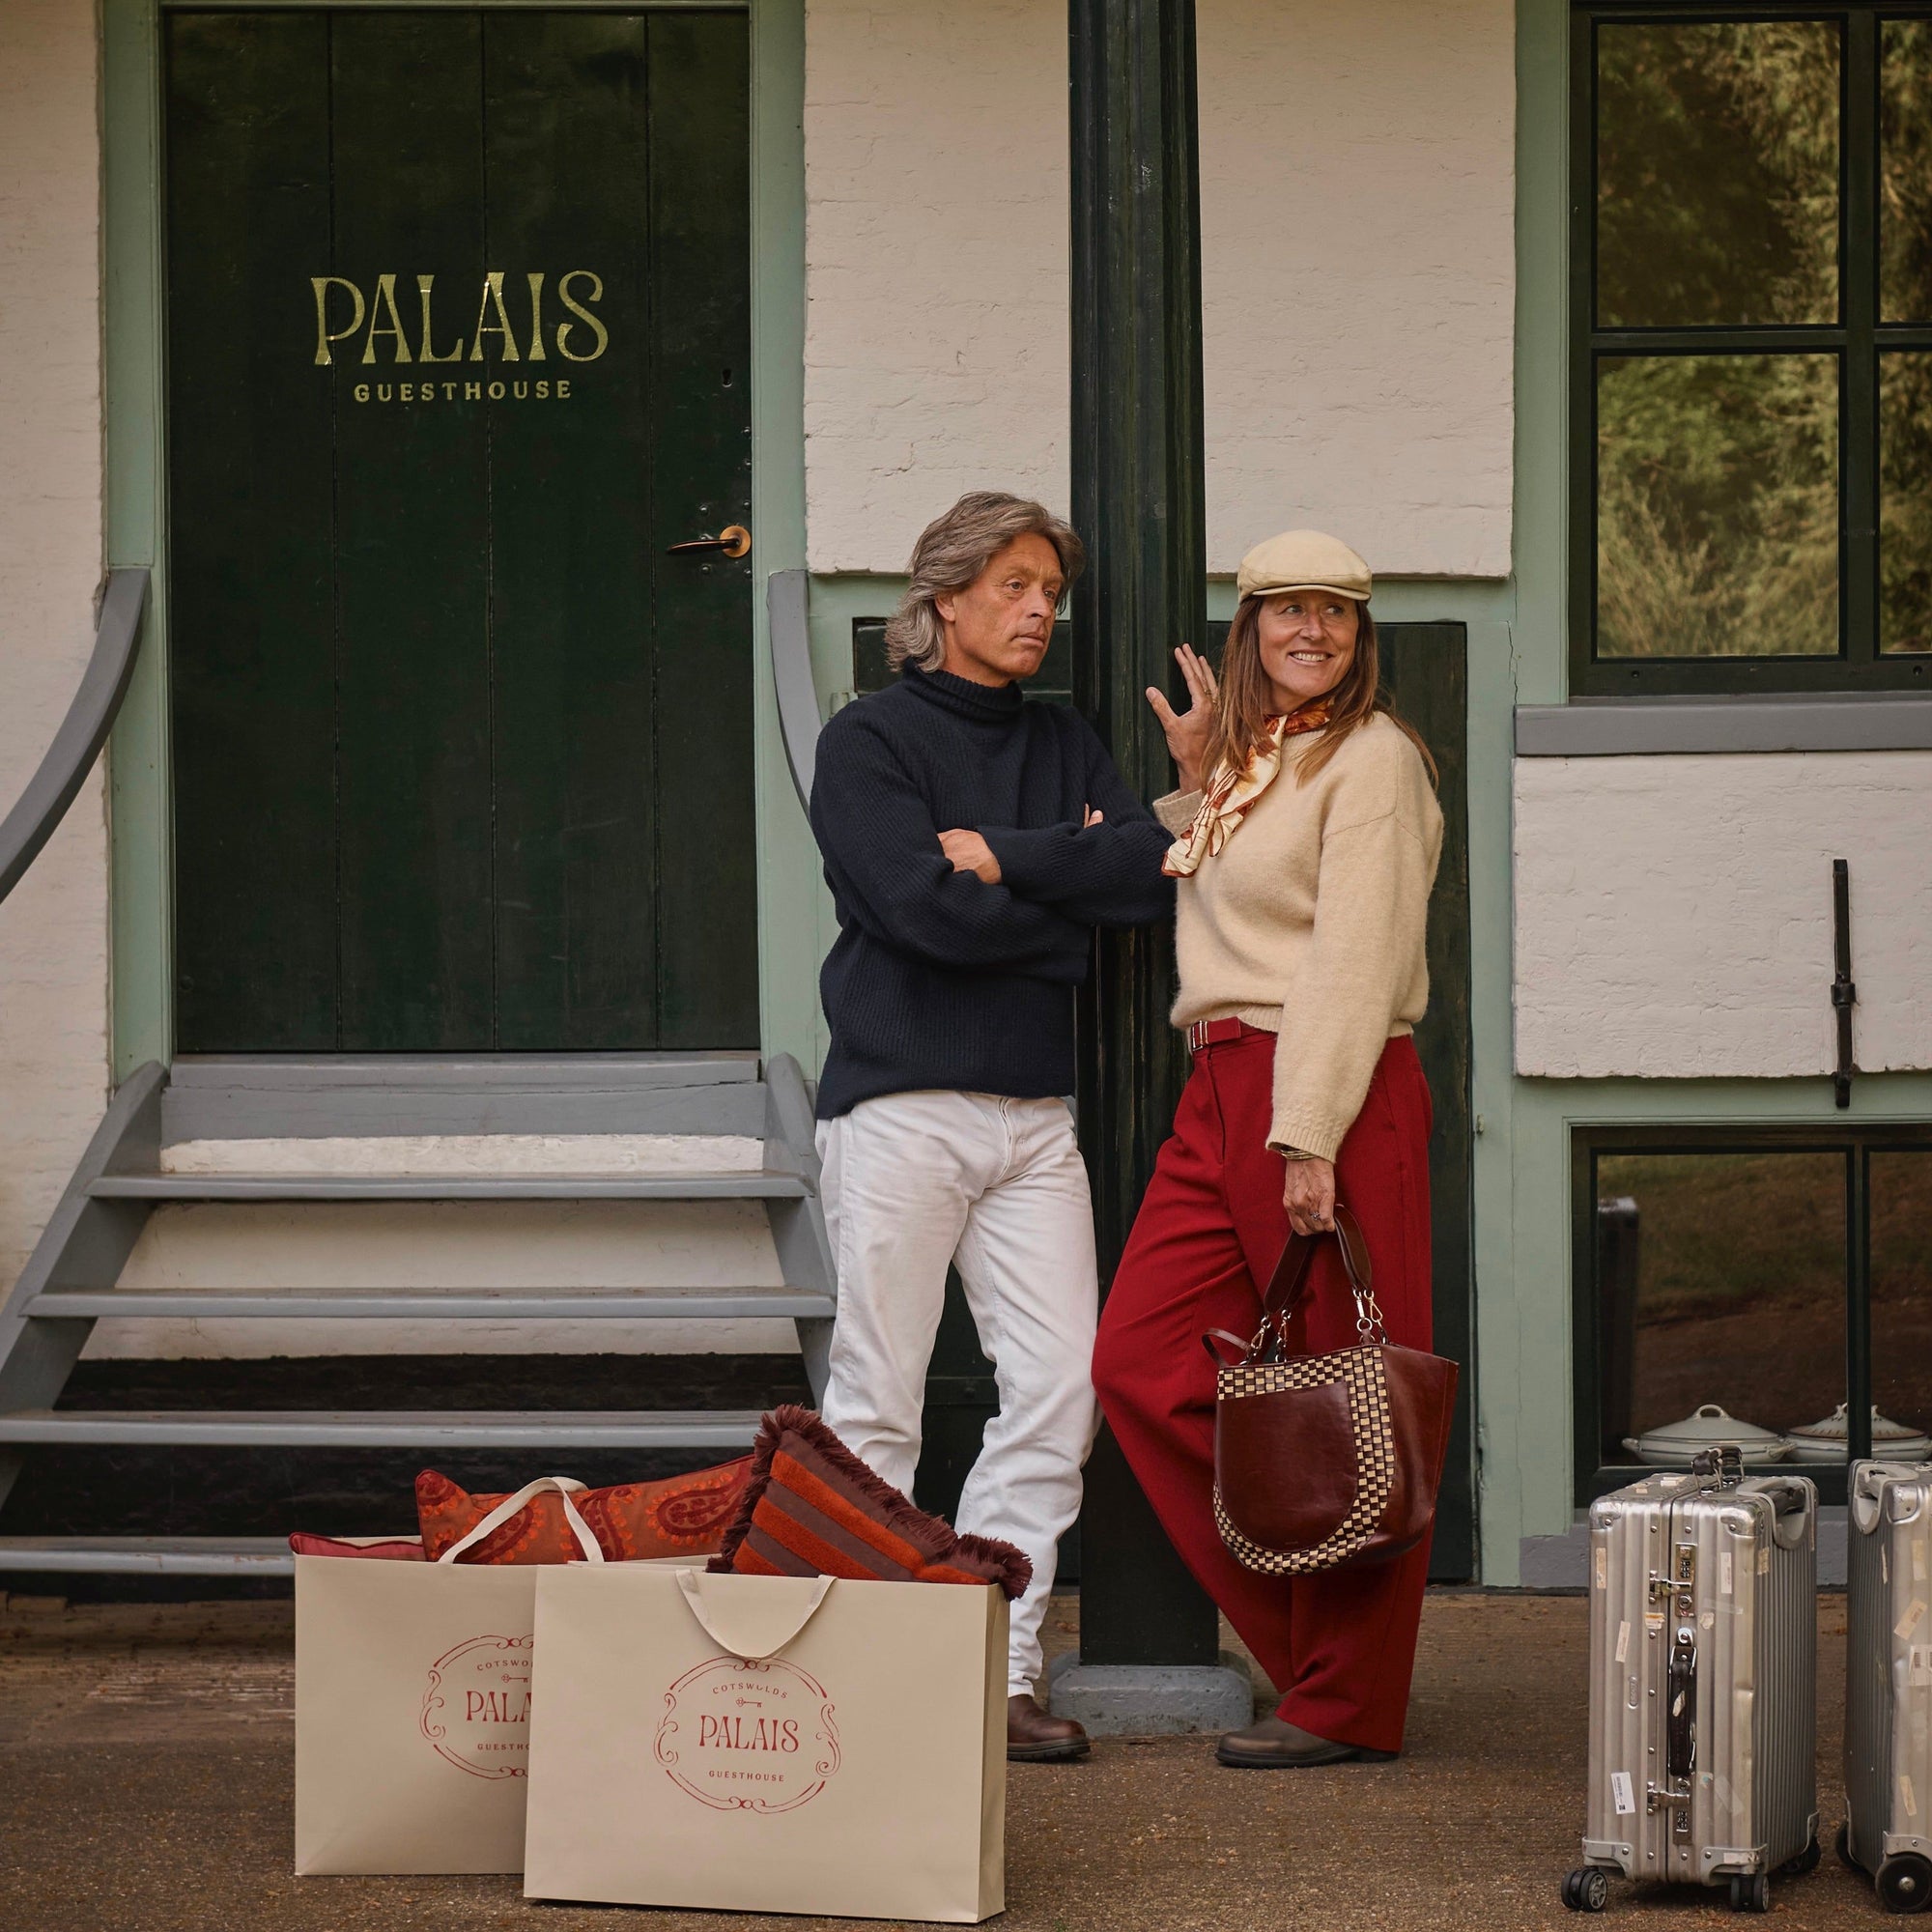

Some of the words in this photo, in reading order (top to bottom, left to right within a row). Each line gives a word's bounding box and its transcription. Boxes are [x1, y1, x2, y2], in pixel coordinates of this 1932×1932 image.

[310, 270, 609, 365] PALAIS
[354, 380, 571, 403] GUESTHOUSE
[476, 1659, 533, 1671] COTSWO
[698, 1715, 800, 1753] PALAIS
[708, 1770, 785, 1782] GUESTHOUSE
